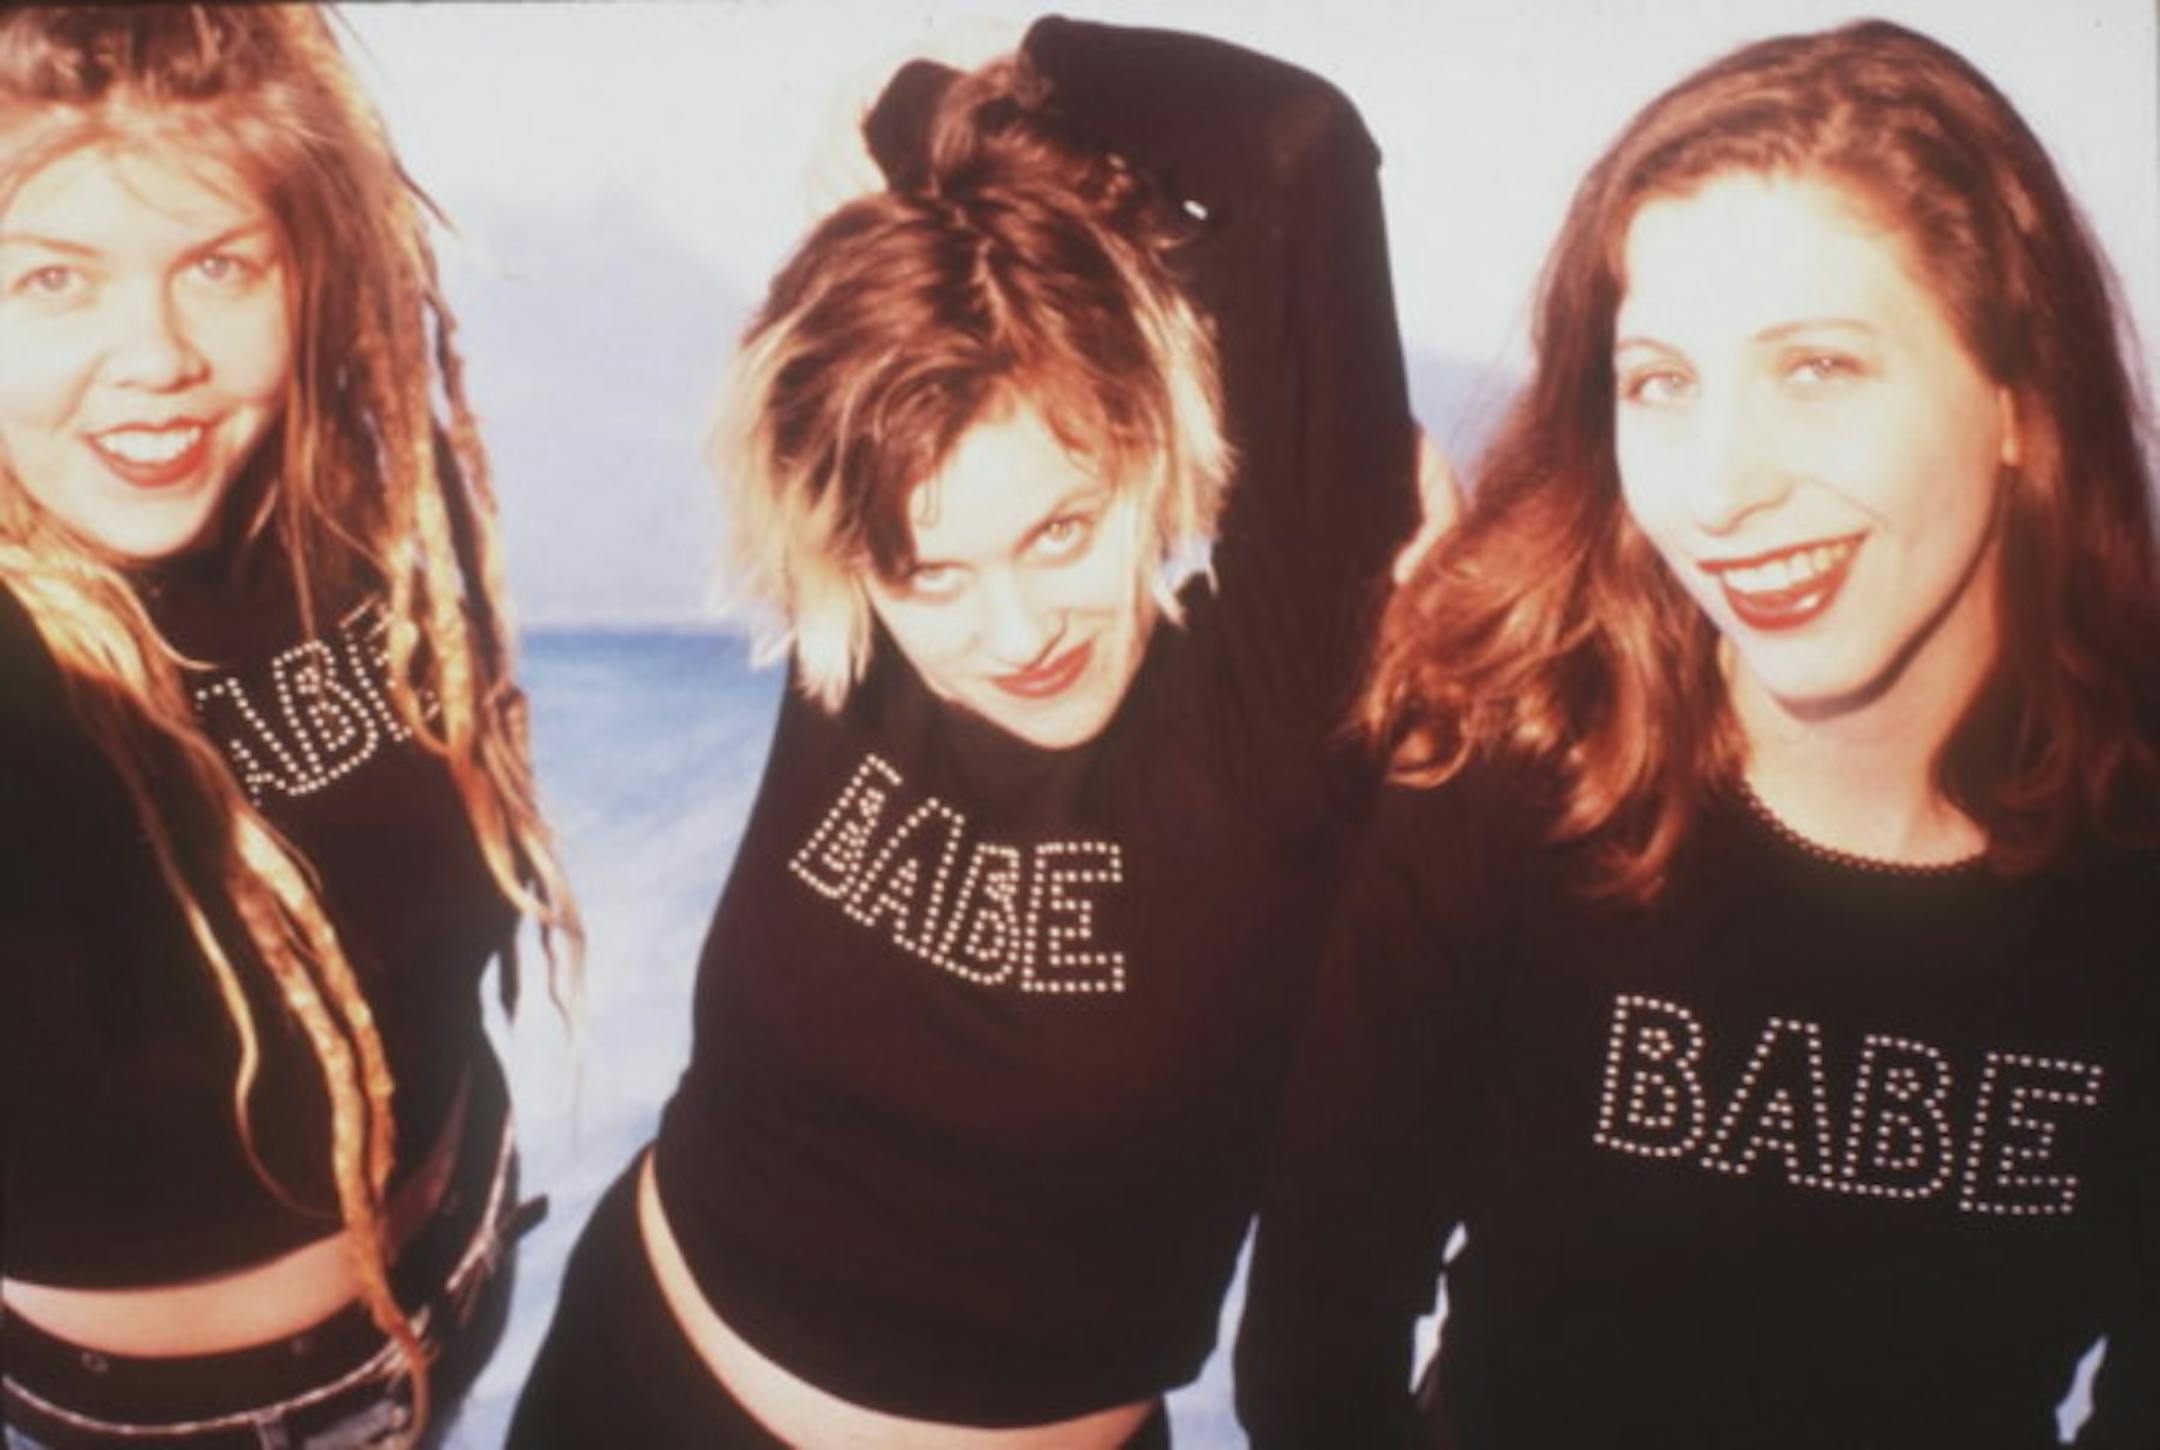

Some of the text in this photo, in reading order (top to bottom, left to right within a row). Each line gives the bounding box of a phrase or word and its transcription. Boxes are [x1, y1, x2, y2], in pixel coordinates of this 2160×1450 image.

[195, 592, 441, 806] ABE
[788, 753, 1126, 993] BABE
[1593, 994, 2103, 1216] BABE
